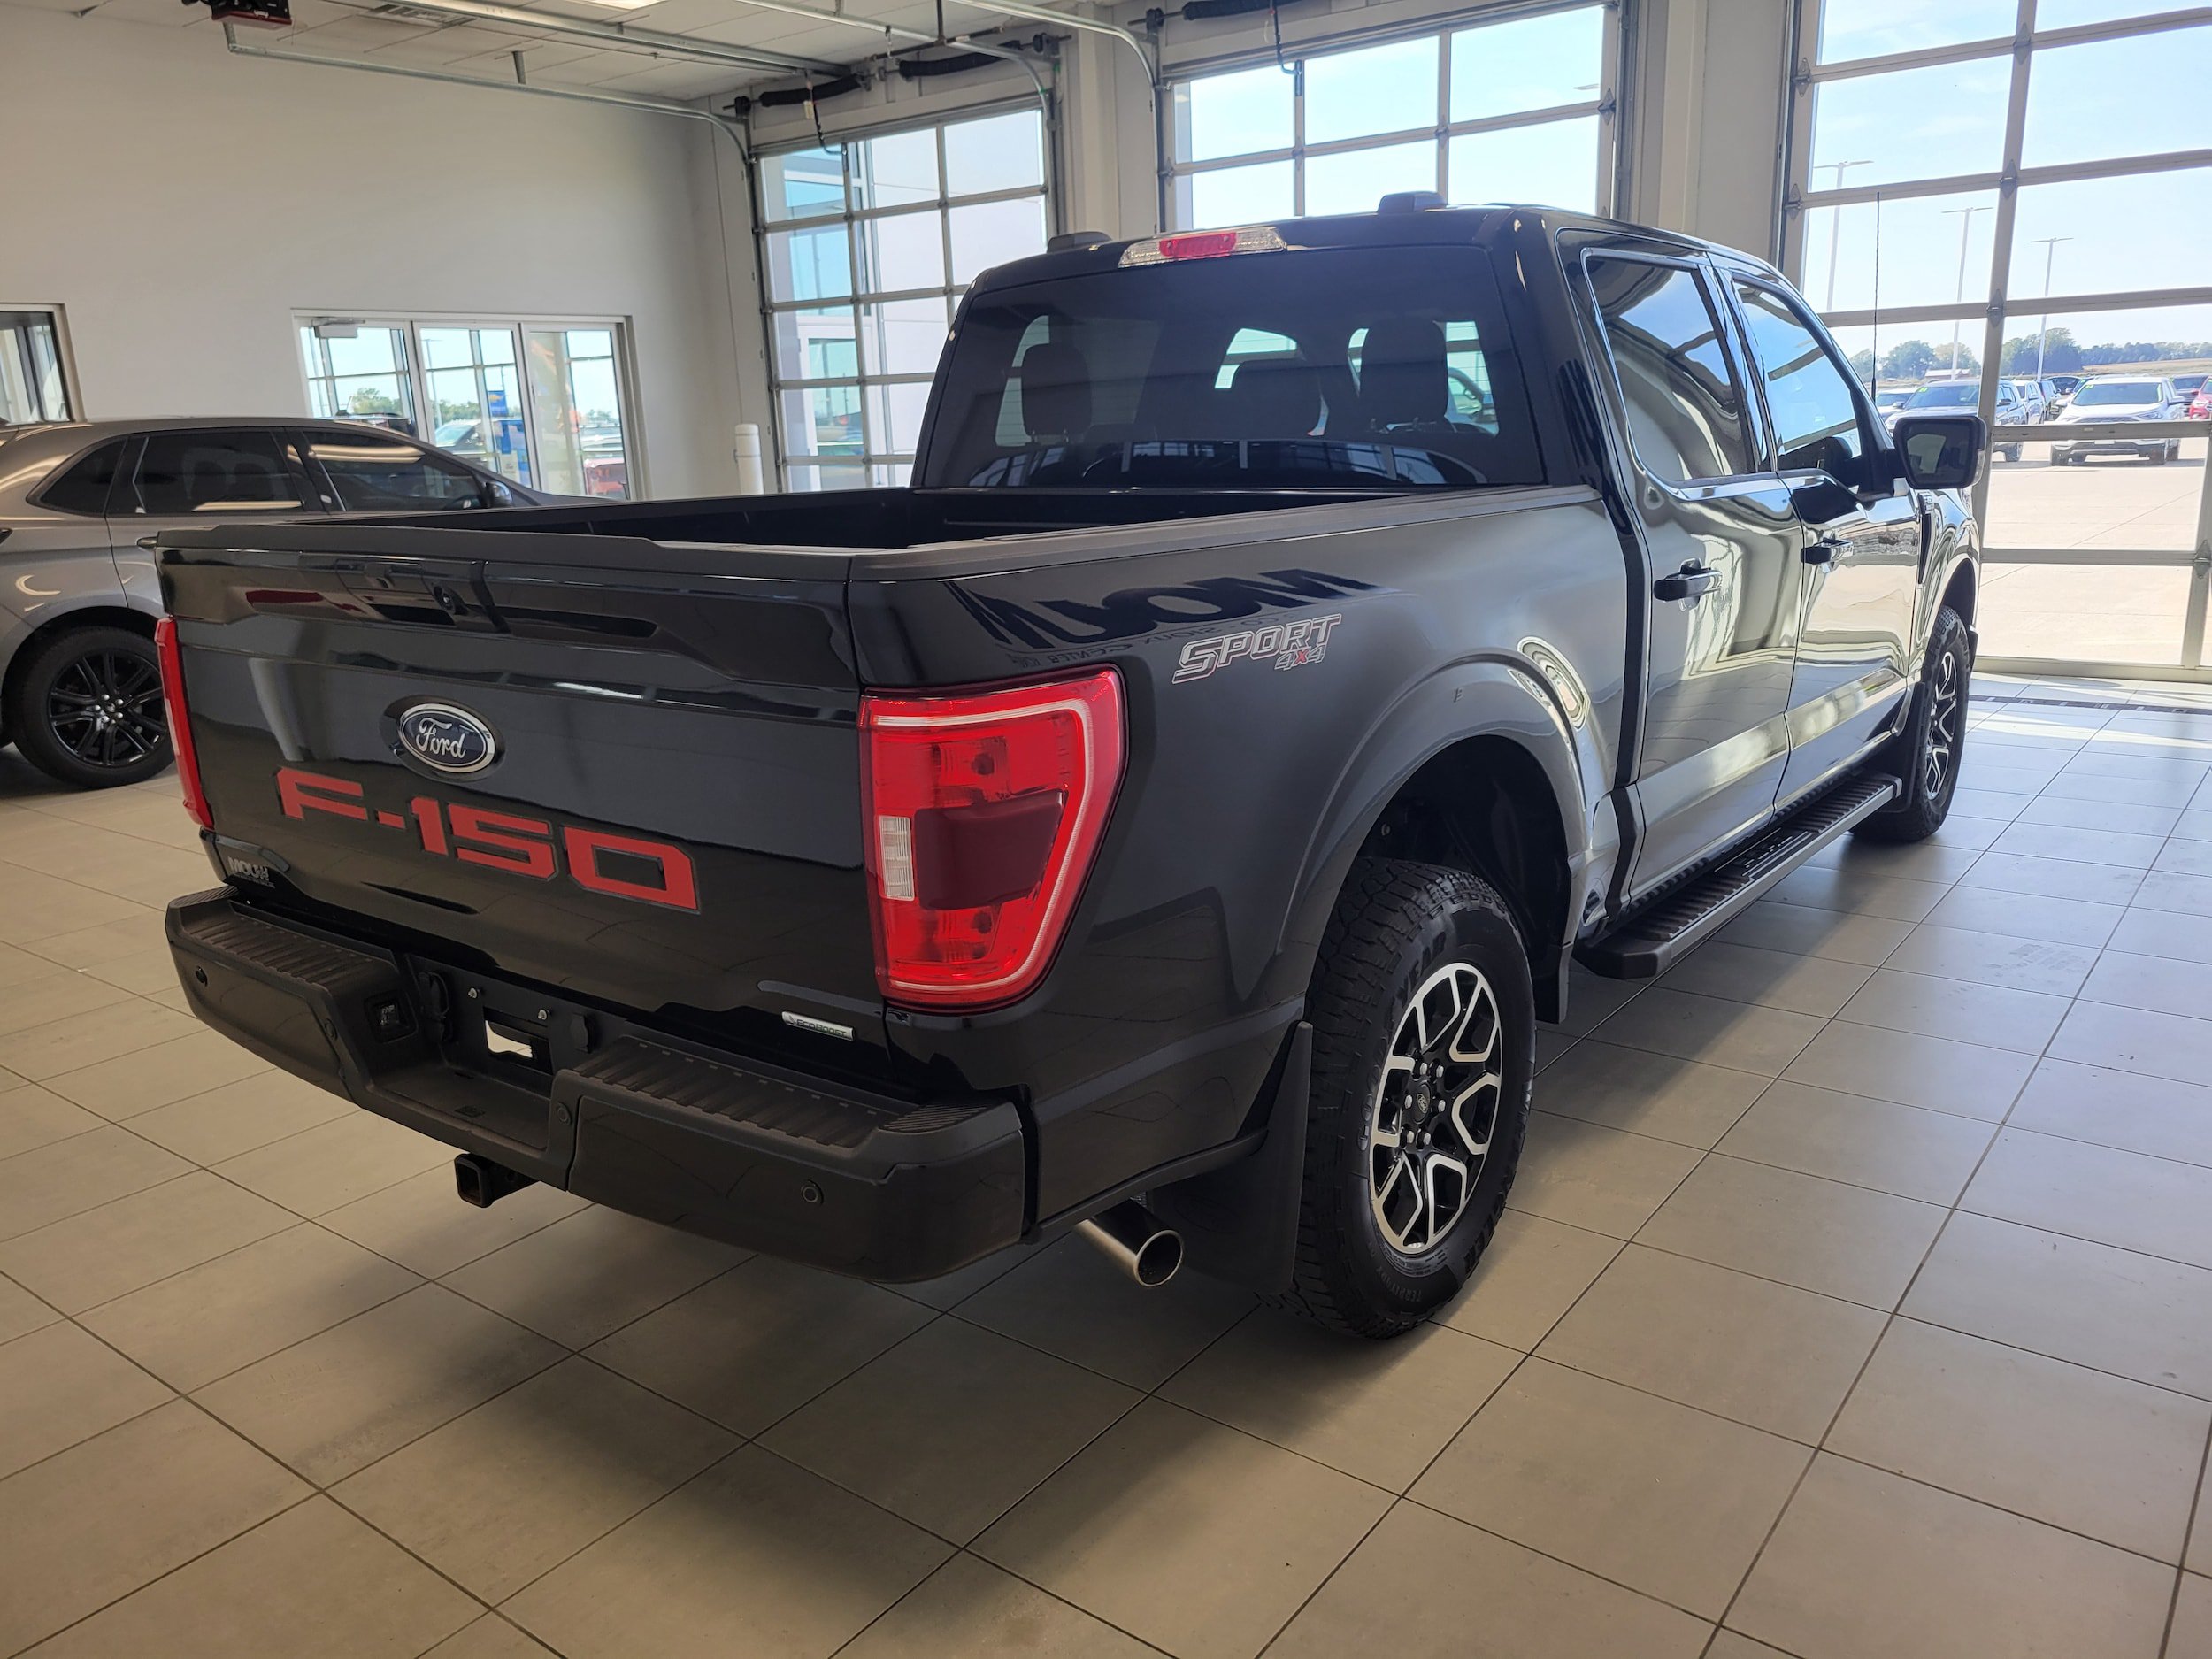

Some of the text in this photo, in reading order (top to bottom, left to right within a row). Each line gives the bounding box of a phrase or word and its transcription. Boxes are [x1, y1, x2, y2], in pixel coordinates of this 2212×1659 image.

[1172, 613, 1342, 684] SPORT
[416, 717, 467, 759] Ford
[275, 766, 701, 914] F-150
